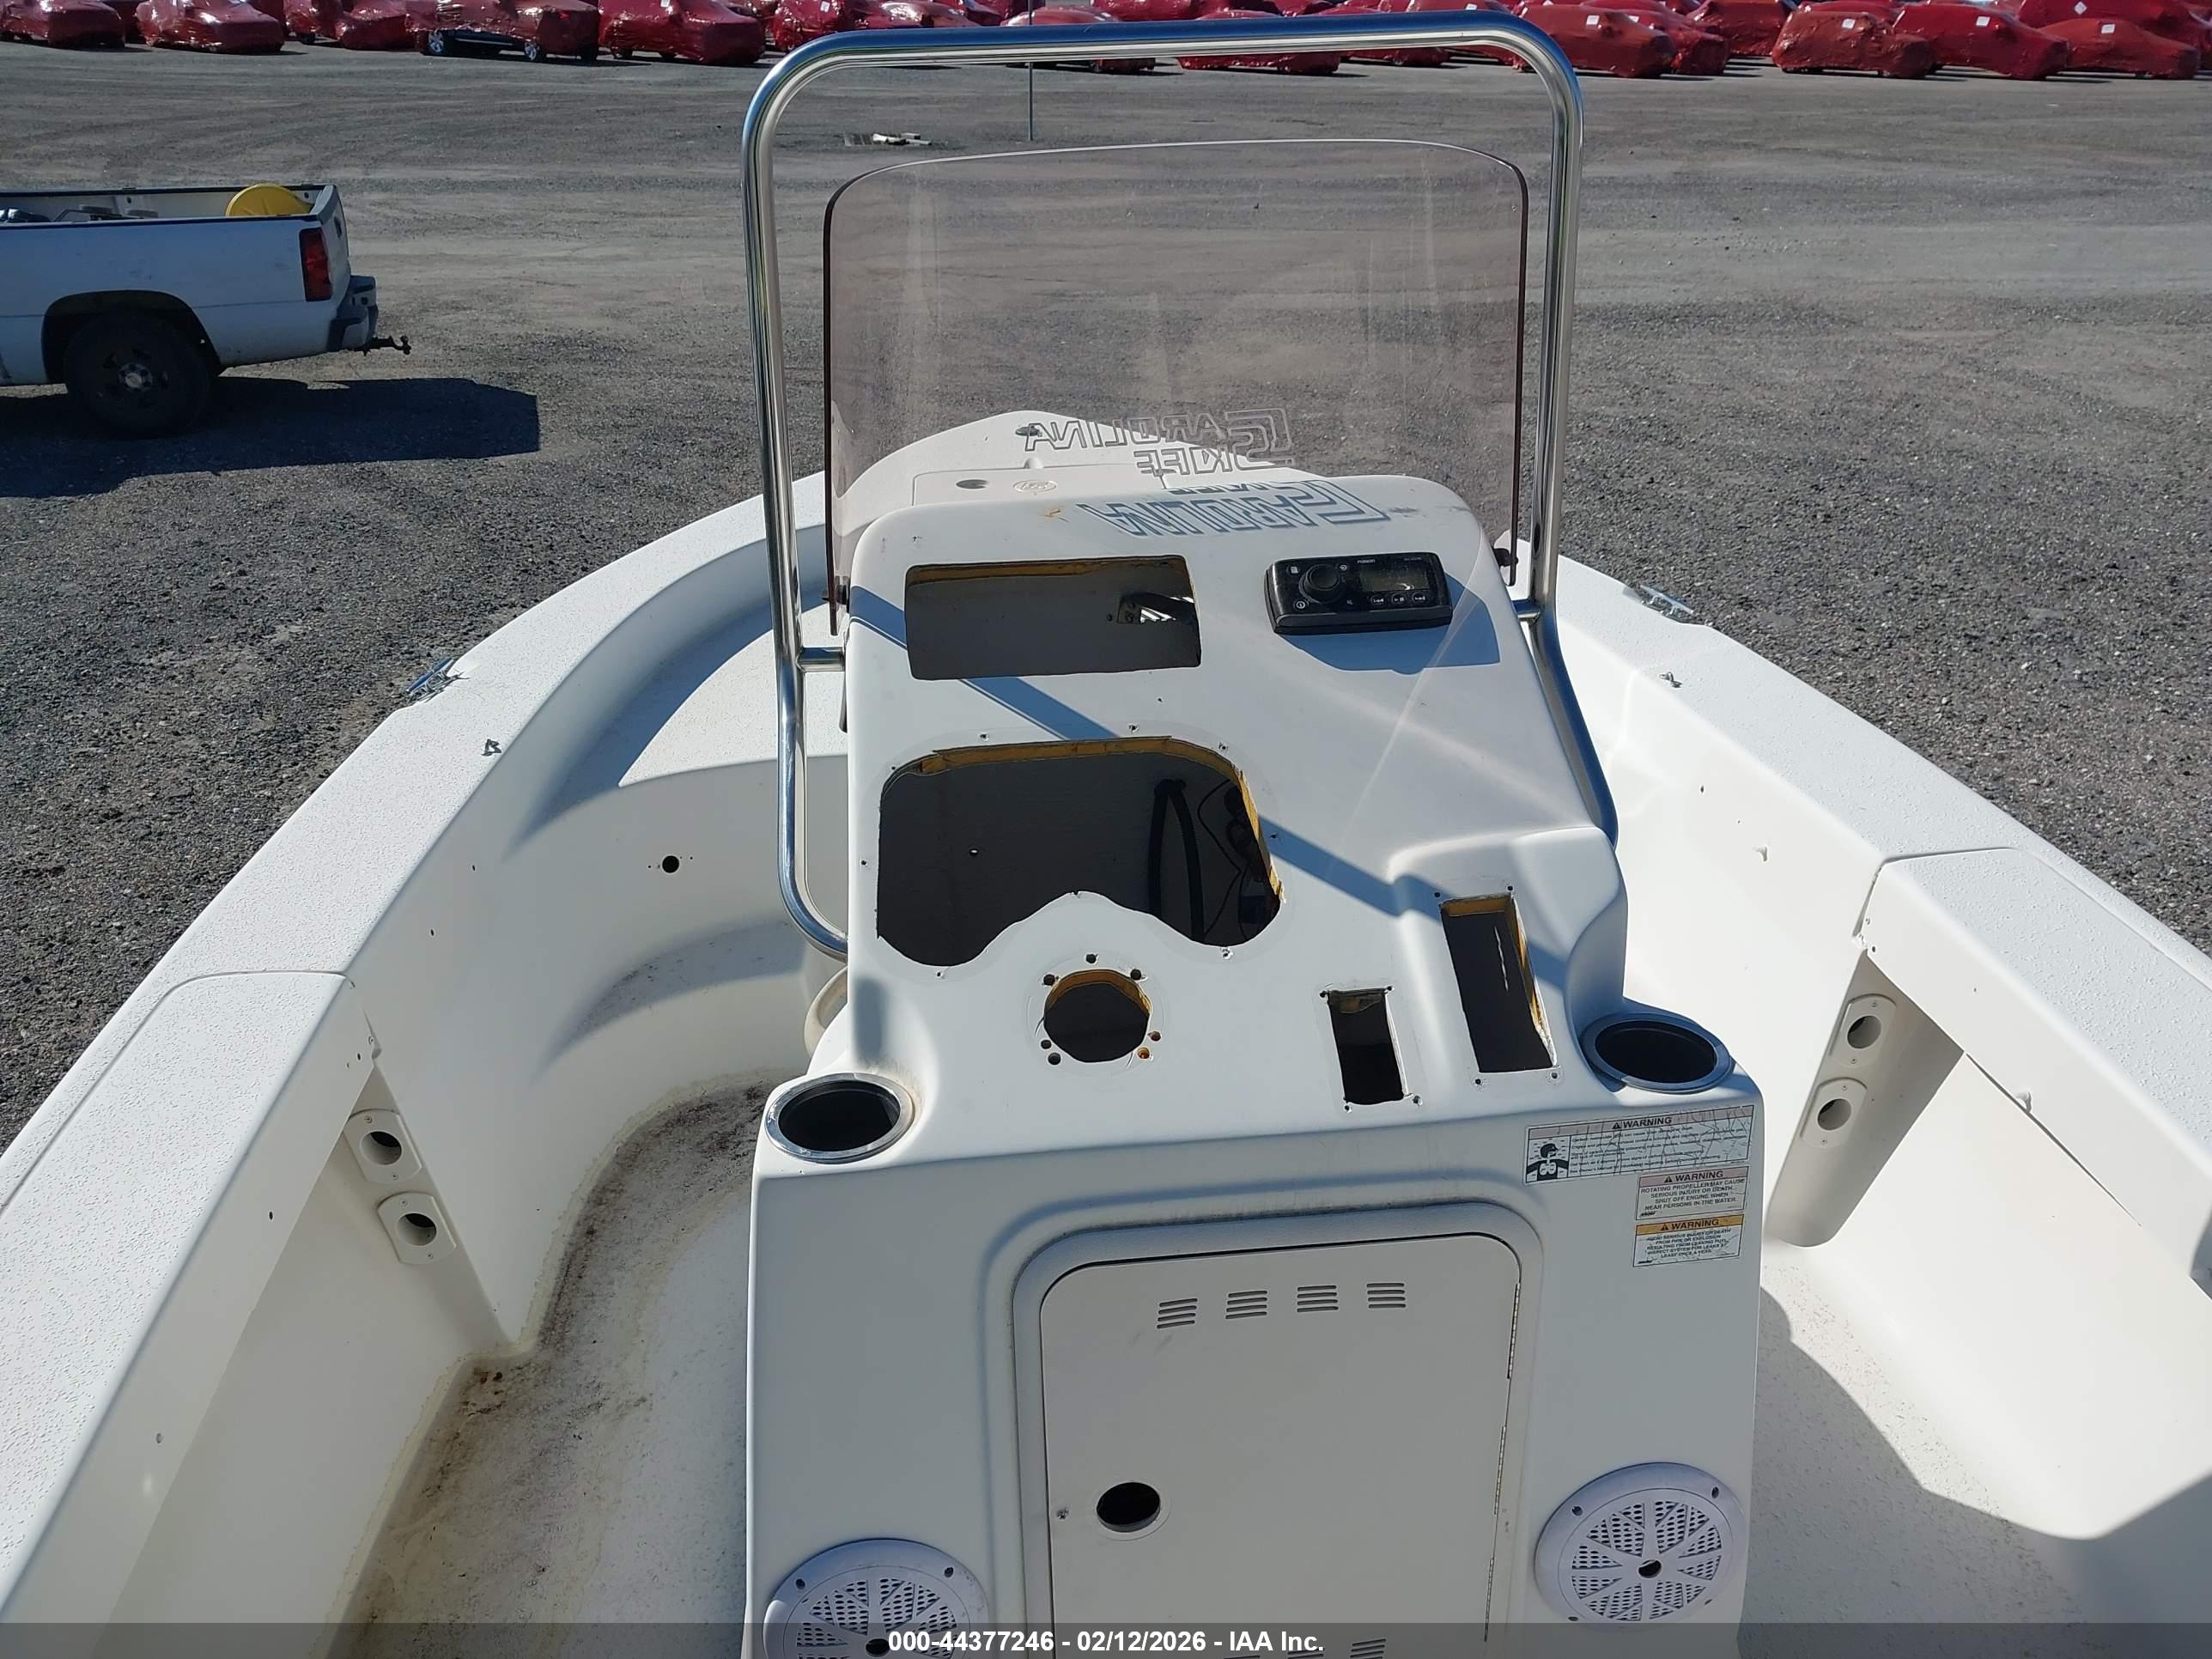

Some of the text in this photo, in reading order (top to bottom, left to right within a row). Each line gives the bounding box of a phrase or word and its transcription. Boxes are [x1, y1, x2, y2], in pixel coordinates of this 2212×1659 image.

[1623, 1117, 1672, 1129] WARNING
[1675, 1170, 1723, 1182] WARNING
[1673, 1182, 1710, 1190] PROPELLER
[1672, 1218, 1719, 1230] WARNING
